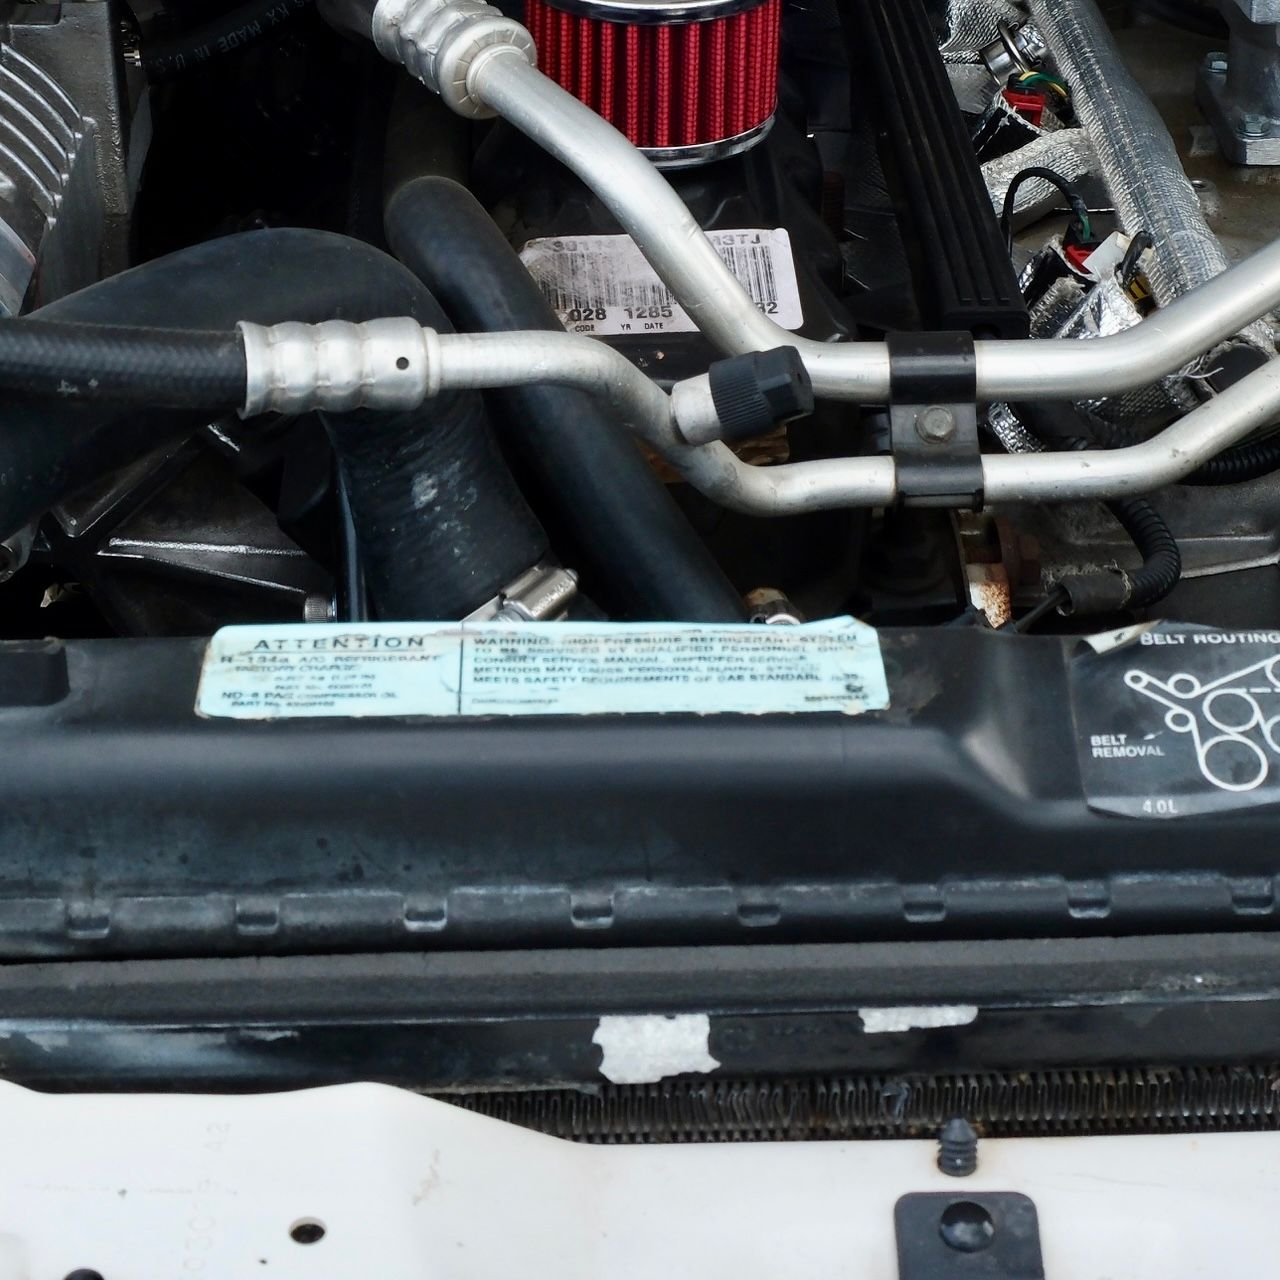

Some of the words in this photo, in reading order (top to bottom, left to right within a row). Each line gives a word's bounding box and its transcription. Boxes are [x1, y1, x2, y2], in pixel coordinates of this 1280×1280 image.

[216, 20, 263, 54] MADE
[191, 45, 211, 64] IN
[574, 324, 596, 333] CODE
[620, 323, 631, 331] YR
[644, 322, 664, 331] DATE
[254, 637, 424, 650] ATTENTION
[1140, 632, 1187, 646] BELT
[1091, 734, 1127, 747] BELT
[1092, 745, 1165, 759] REMOVAL
[1142, 799, 1178, 815] 4.0L
